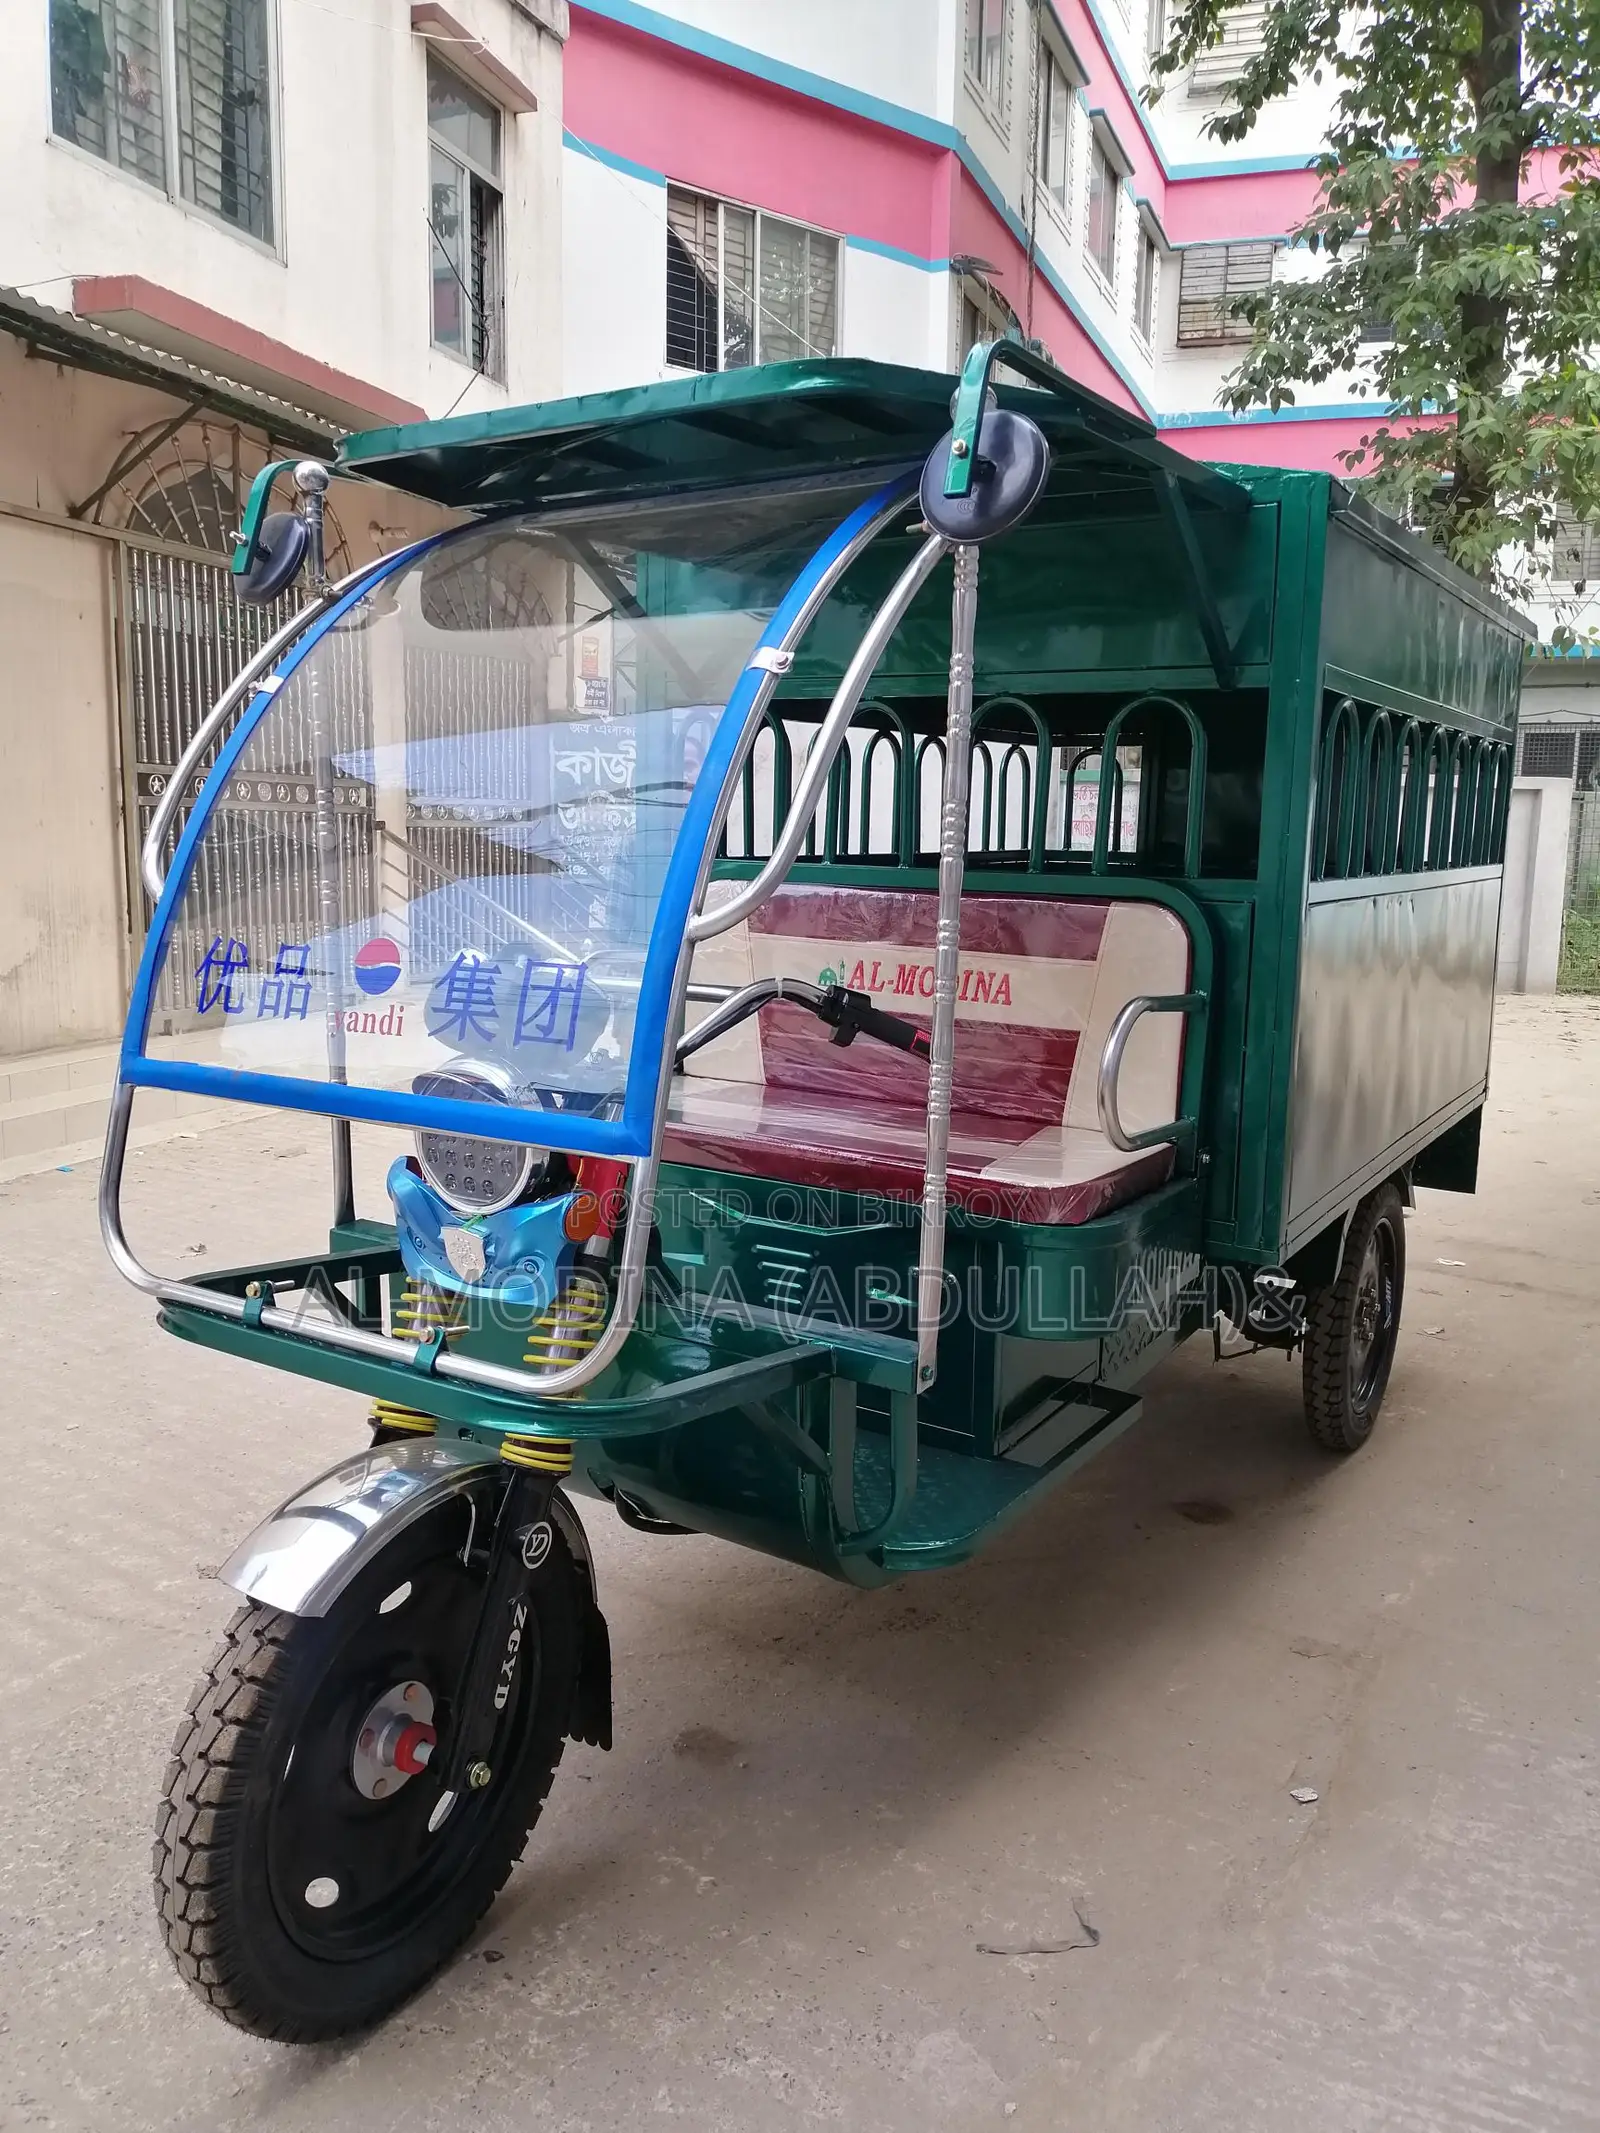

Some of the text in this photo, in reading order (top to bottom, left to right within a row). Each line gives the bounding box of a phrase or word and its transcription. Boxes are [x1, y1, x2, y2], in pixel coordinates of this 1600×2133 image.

[195, 936, 312, 1021] 优品
[427, 952, 588, 1053] 集团
[846, 959, 1012, 1006] AL-MOINA
